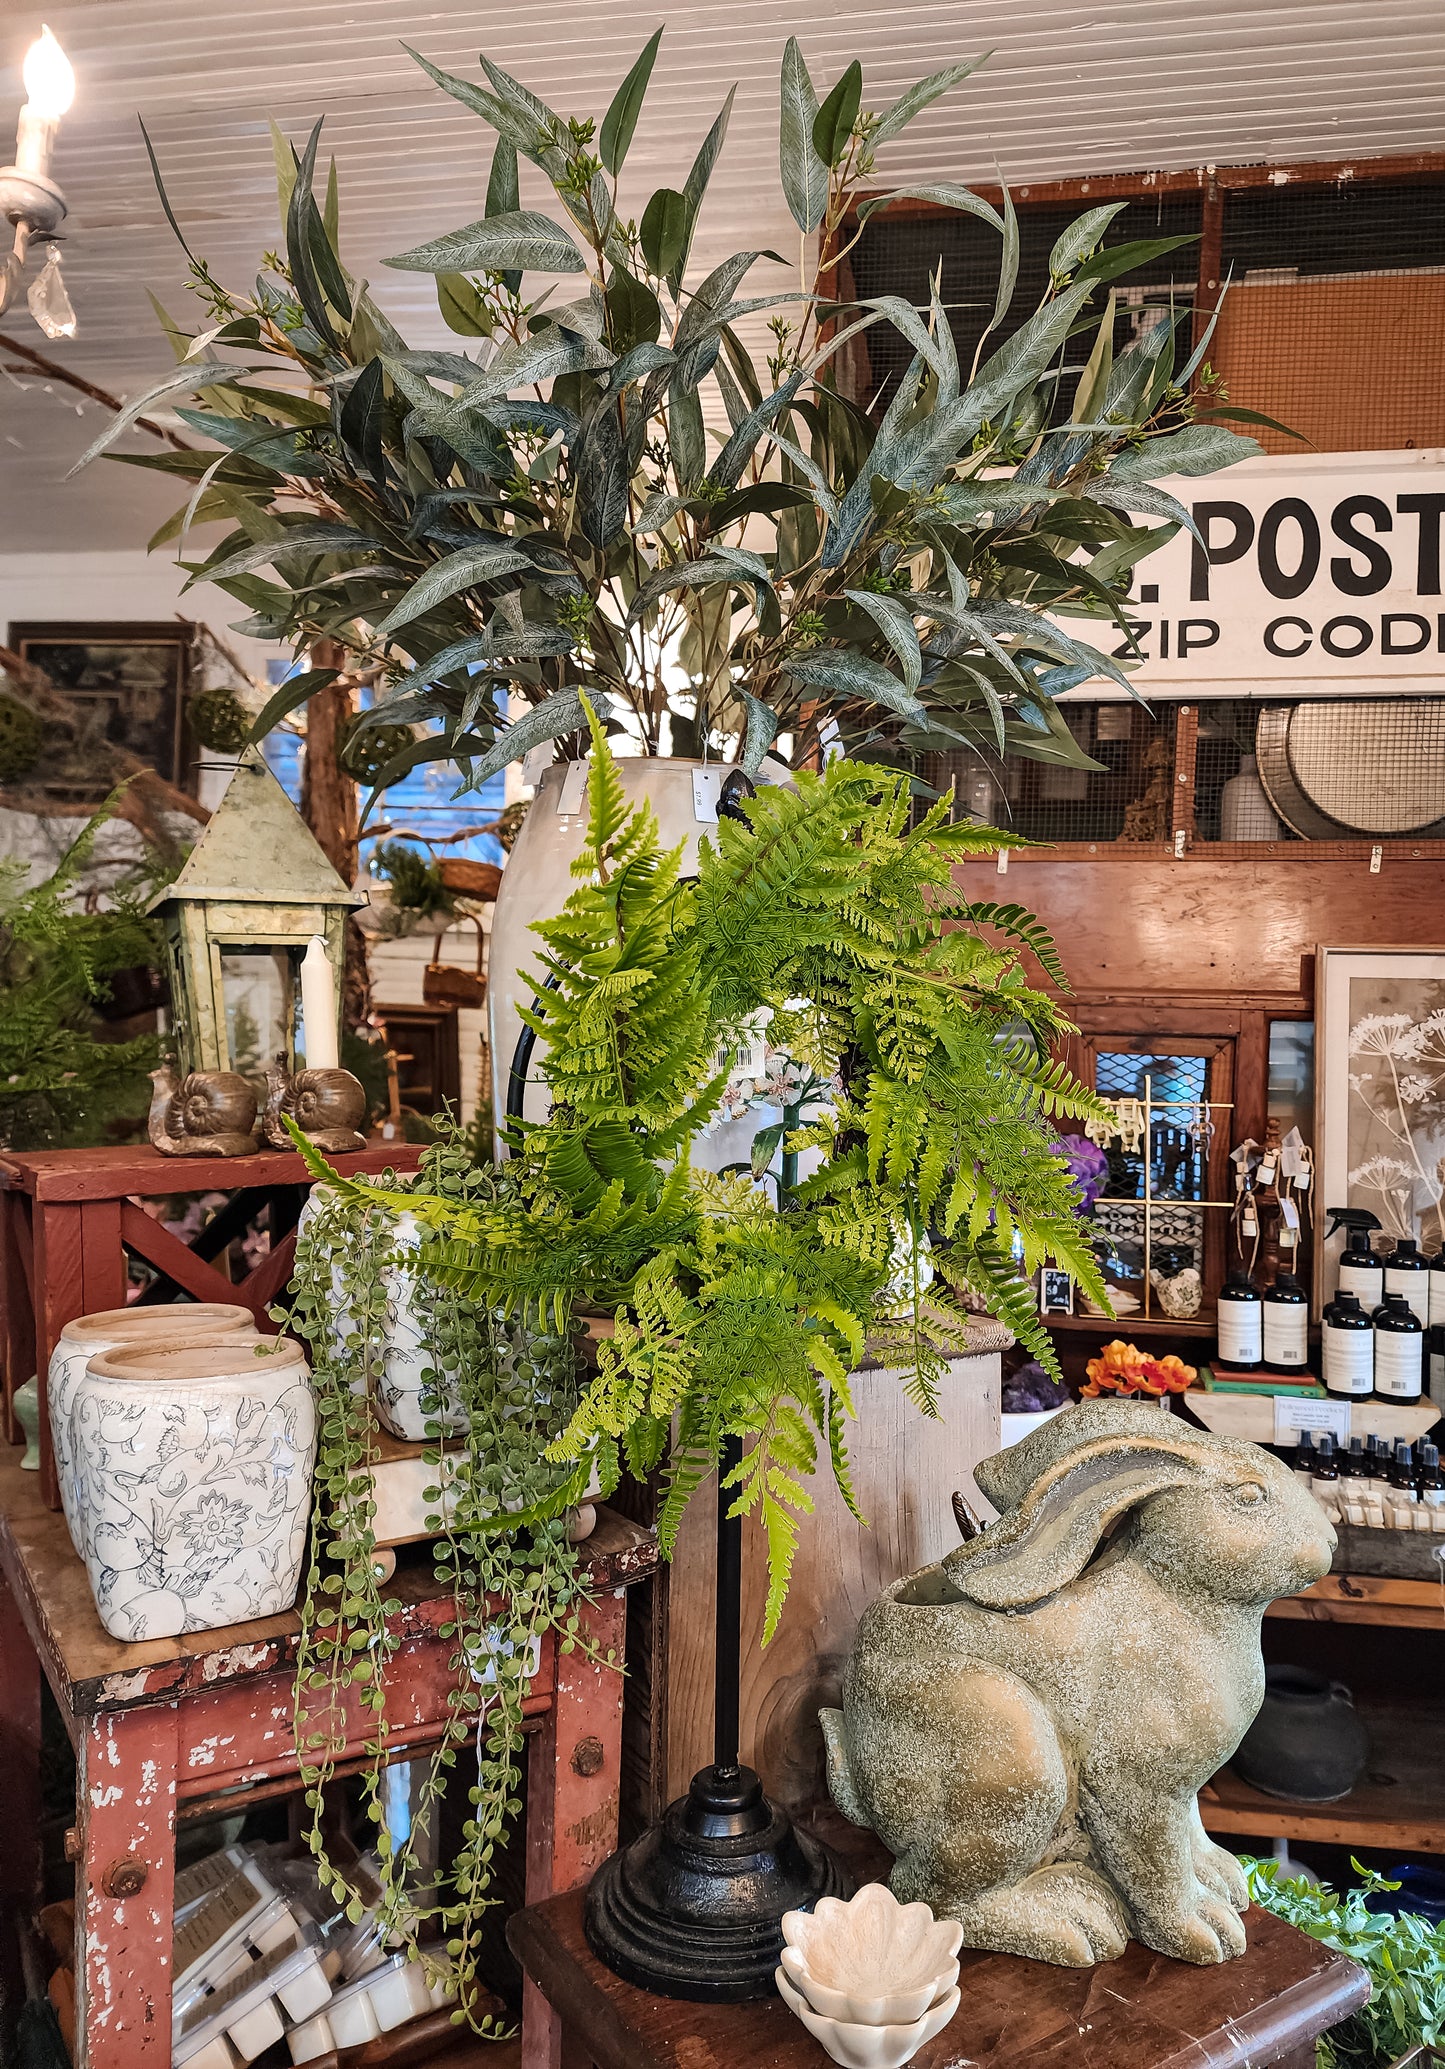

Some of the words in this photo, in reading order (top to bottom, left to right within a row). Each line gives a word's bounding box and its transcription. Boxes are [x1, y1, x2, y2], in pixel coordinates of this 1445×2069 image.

[1190, 493, 1445, 602] POST
[1110, 619, 1221, 660] ZIP
[1263, 613, 1445, 658] COD
